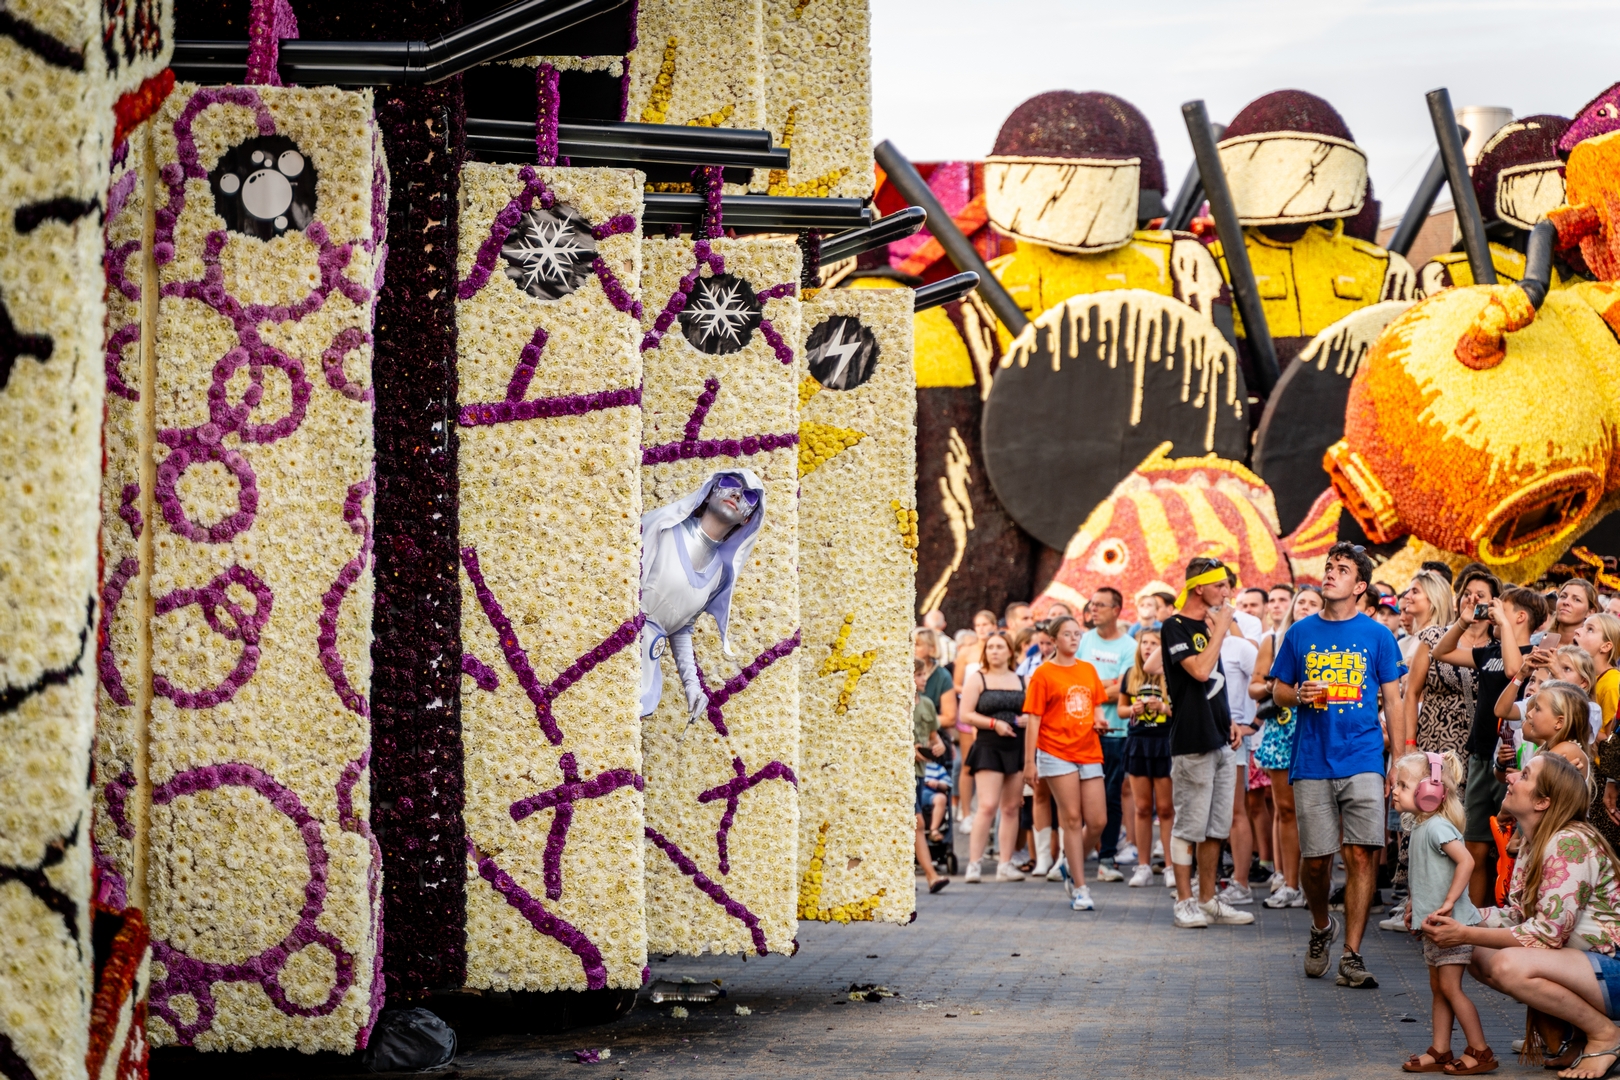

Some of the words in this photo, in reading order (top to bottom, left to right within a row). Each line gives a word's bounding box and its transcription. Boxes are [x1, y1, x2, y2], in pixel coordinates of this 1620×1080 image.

[1307, 652, 1365, 669] SPEEL
[1482, 658, 1504, 671] PUM
[1309, 669, 1363, 685] GOED
[1328, 686, 1358, 698] VEN
